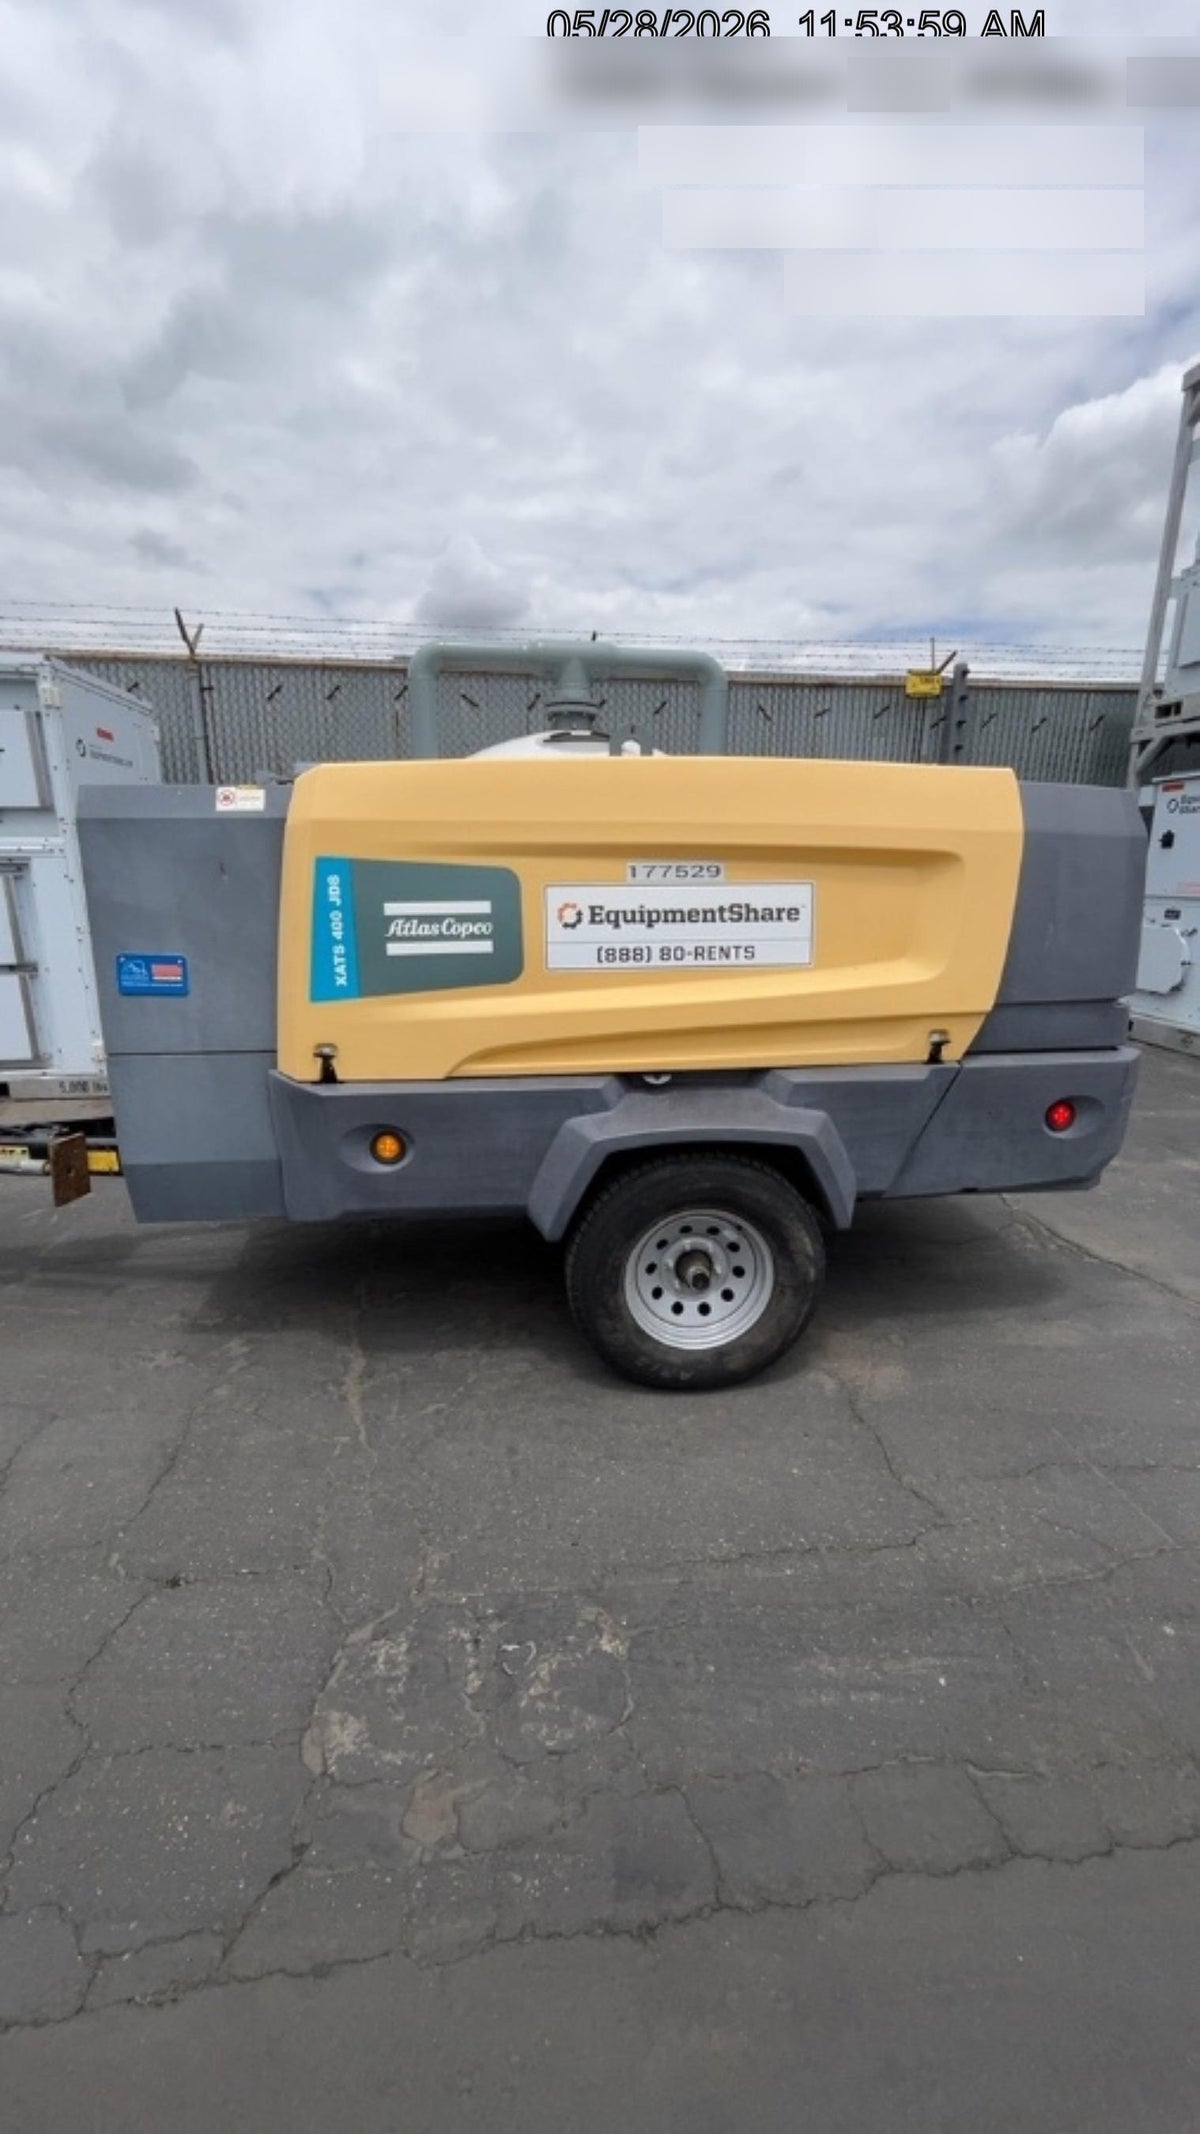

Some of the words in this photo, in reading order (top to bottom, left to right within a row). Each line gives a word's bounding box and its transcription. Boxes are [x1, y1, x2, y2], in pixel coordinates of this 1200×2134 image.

[628, 864, 721, 879] 177529
[329, 910, 343, 940] 400
[588, 903, 801, 929] EquipmentShare
[332, 944, 348, 987] XATS
[596, 945, 652, 964] (888)
[658, 945, 756, 963] 80-RENTS
